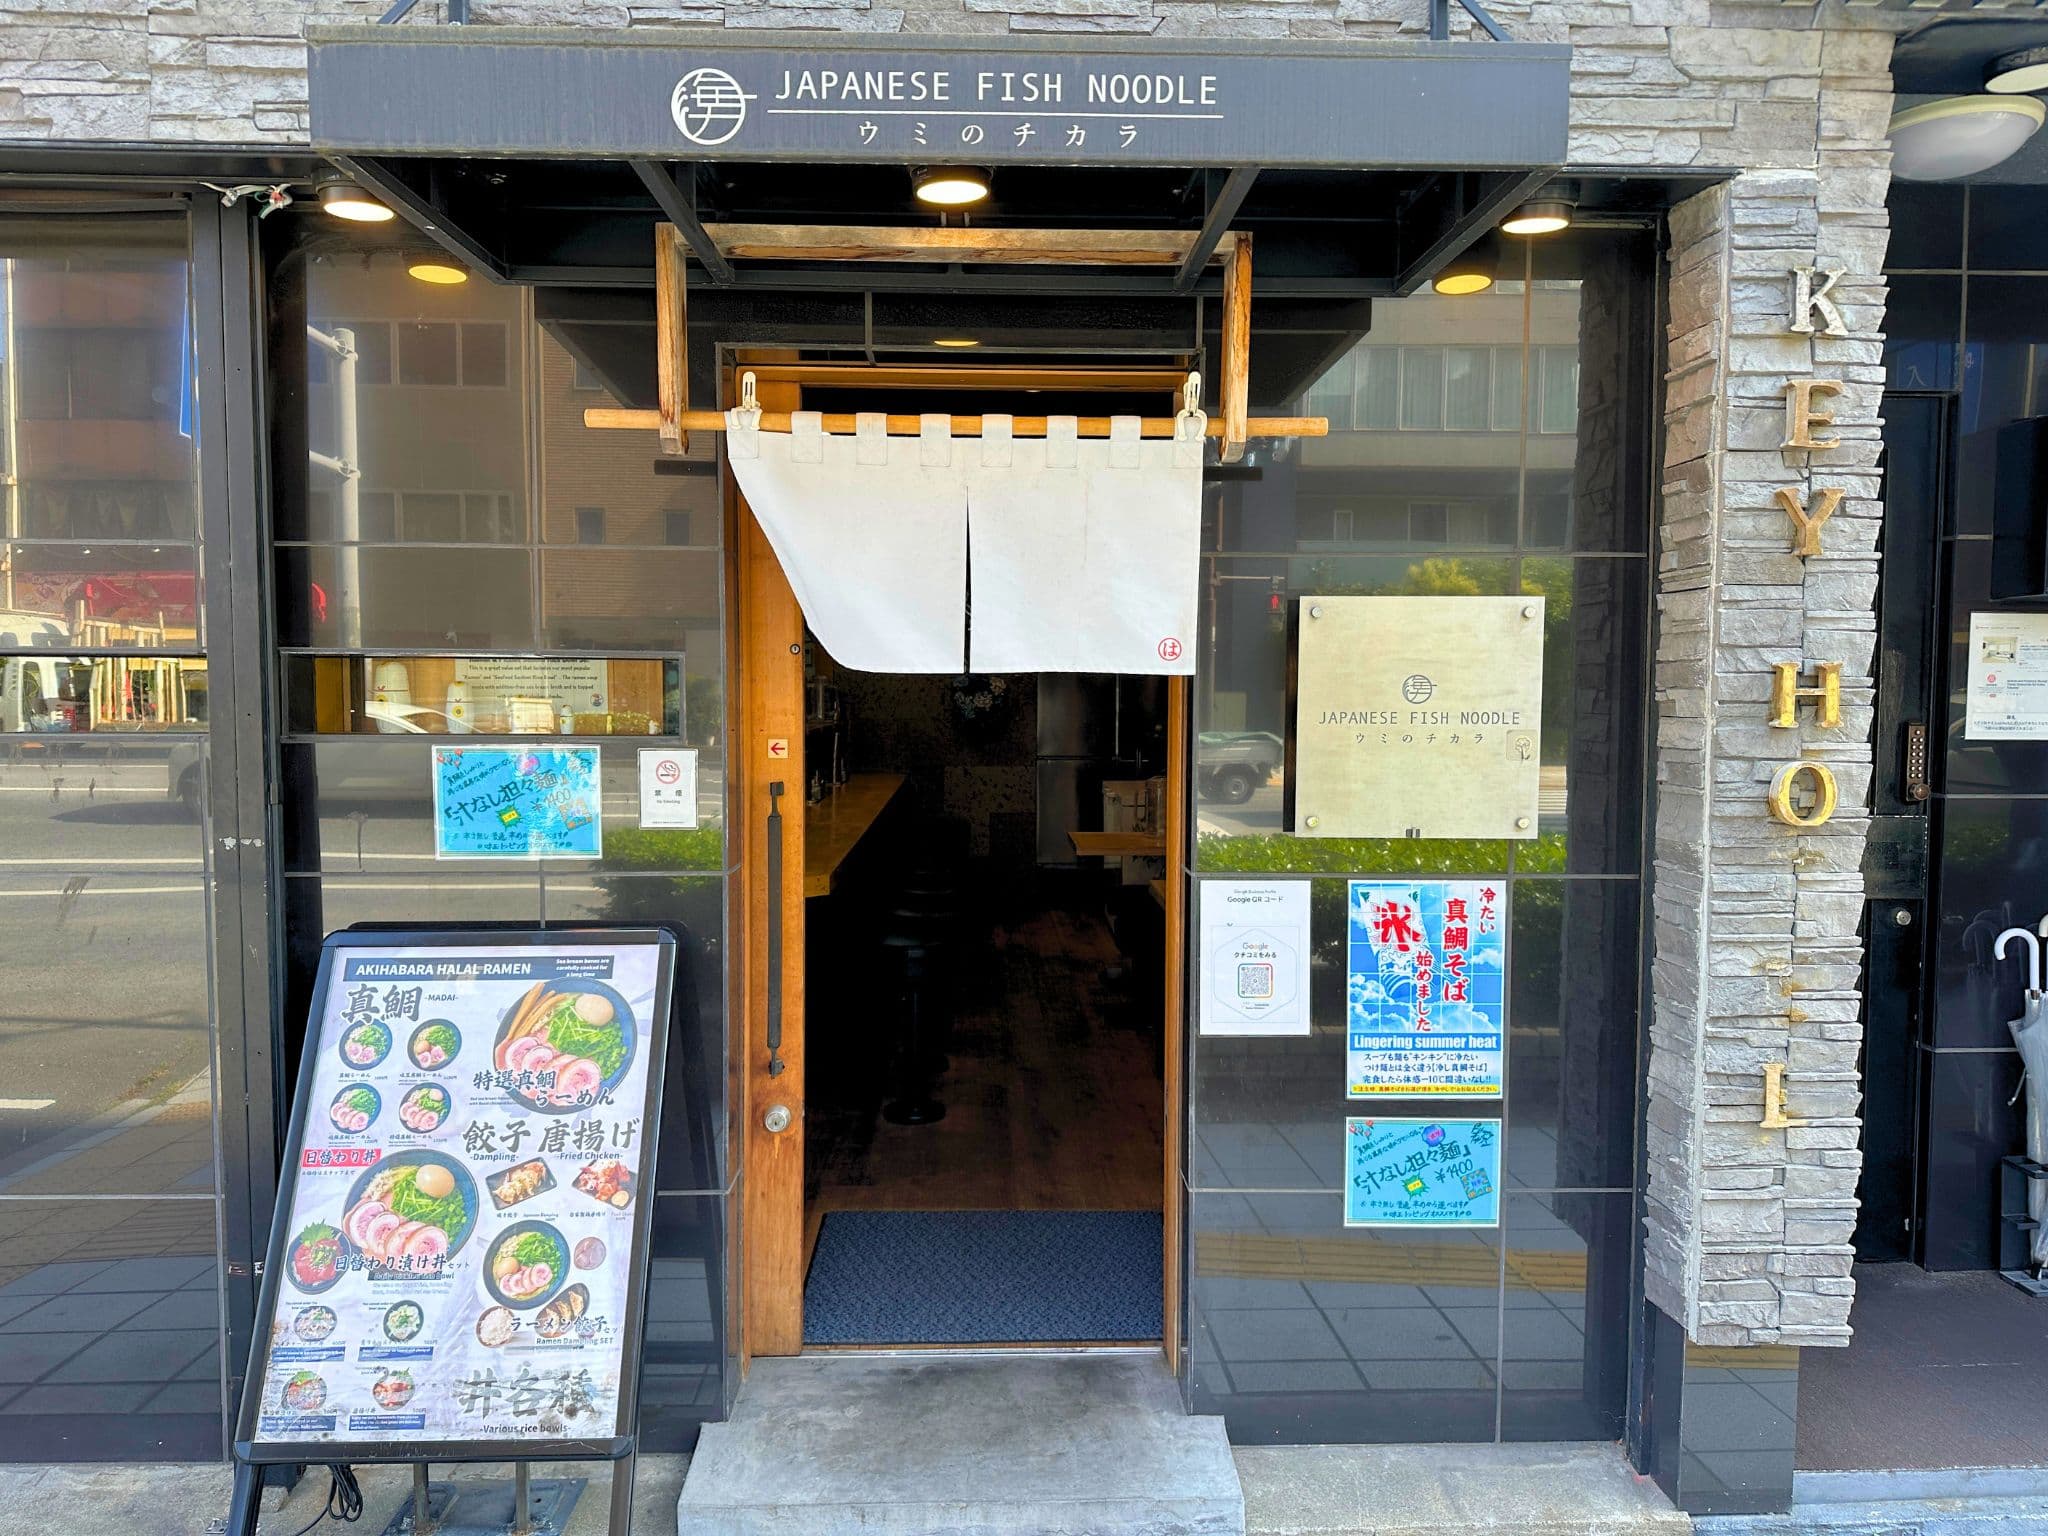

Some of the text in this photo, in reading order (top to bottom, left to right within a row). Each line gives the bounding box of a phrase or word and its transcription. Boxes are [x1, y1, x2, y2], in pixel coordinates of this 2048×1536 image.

[775, 71, 1218, 105] JAPANESE FISH NOODLE
[859, 121, 1138, 149] ウミのチカラ
[1161, 640, 1180, 658] は
[1319, 711, 1521, 725] JAPANESE FISH NOODLE
[1356, 733, 1486, 745] ウミのチカラ
[1227, 896, 1251, 904] Google
[1479, 887, 1497, 934] 冷たい
[1373, 900, 1423, 953] 氷
[1443, 897, 1469, 1002] 真鯛そば
[356, 962, 532, 977] AKIHABARA HALAL RAMEN
[1416, 950, 1433, 1032] 始めました
[341, 983, 423, 1024] 真鯛
[1354, 1035, 1498, 1050] Lingering summer heat
[472, 1069, 557, 1091] 特選真鯛
[535, 1087, 615, 1108] らーめん
[462, 1117, 641, 1154] 餃子 唐揚げ
[306, 1149, 376, 1165] 日替わり丼
[470, 1153, 519, 1162] -Dampling-
[584, 1152, 623, 1160] Chicken-
[520, 1424, 538, 1433] rice
